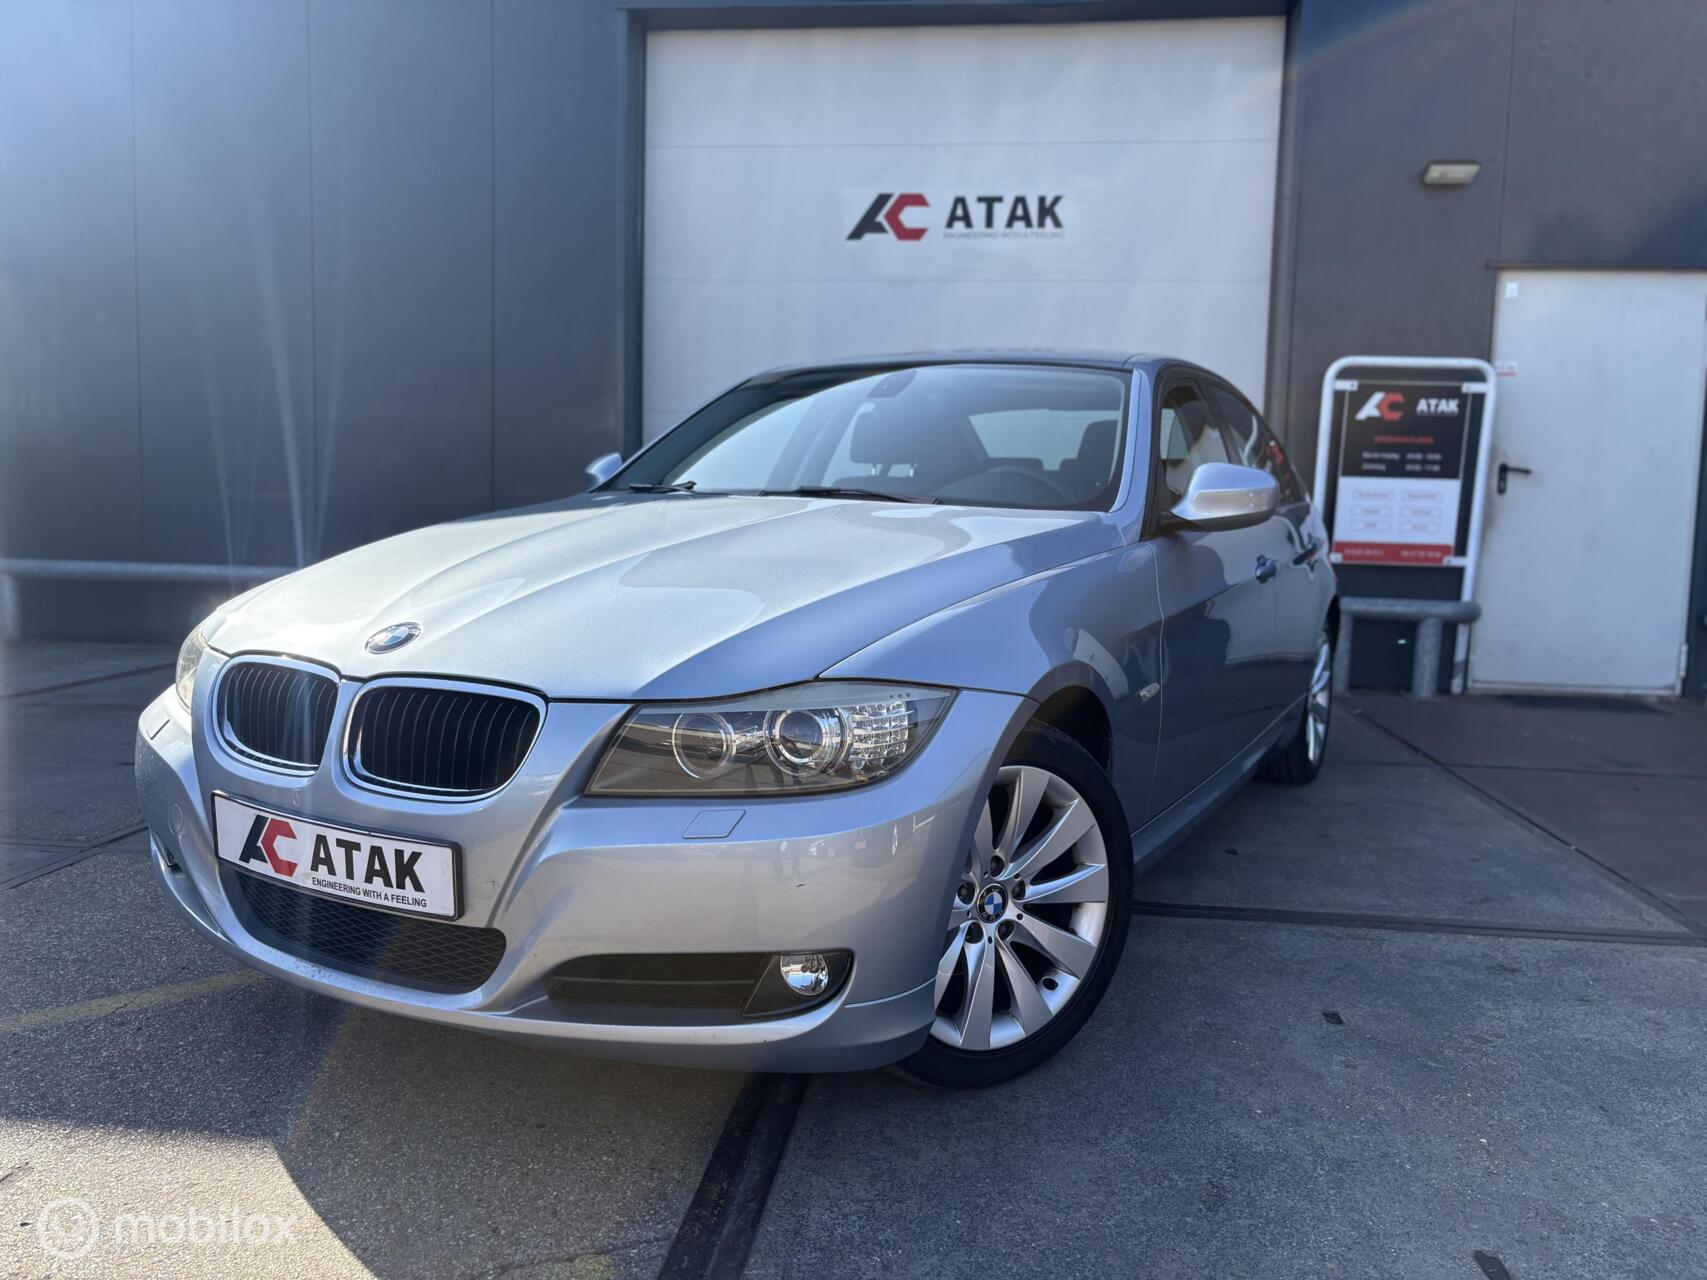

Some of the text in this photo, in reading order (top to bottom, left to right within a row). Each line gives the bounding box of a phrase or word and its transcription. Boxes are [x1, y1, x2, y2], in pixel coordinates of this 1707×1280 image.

[945, 195, 1063, 229] ATAK
[1417, 398, 1459, 412] ATAK
[310, 834, 426, 893] ATAK
[312, 877, 426, 907] ENGINEERING WITH A FEELING
